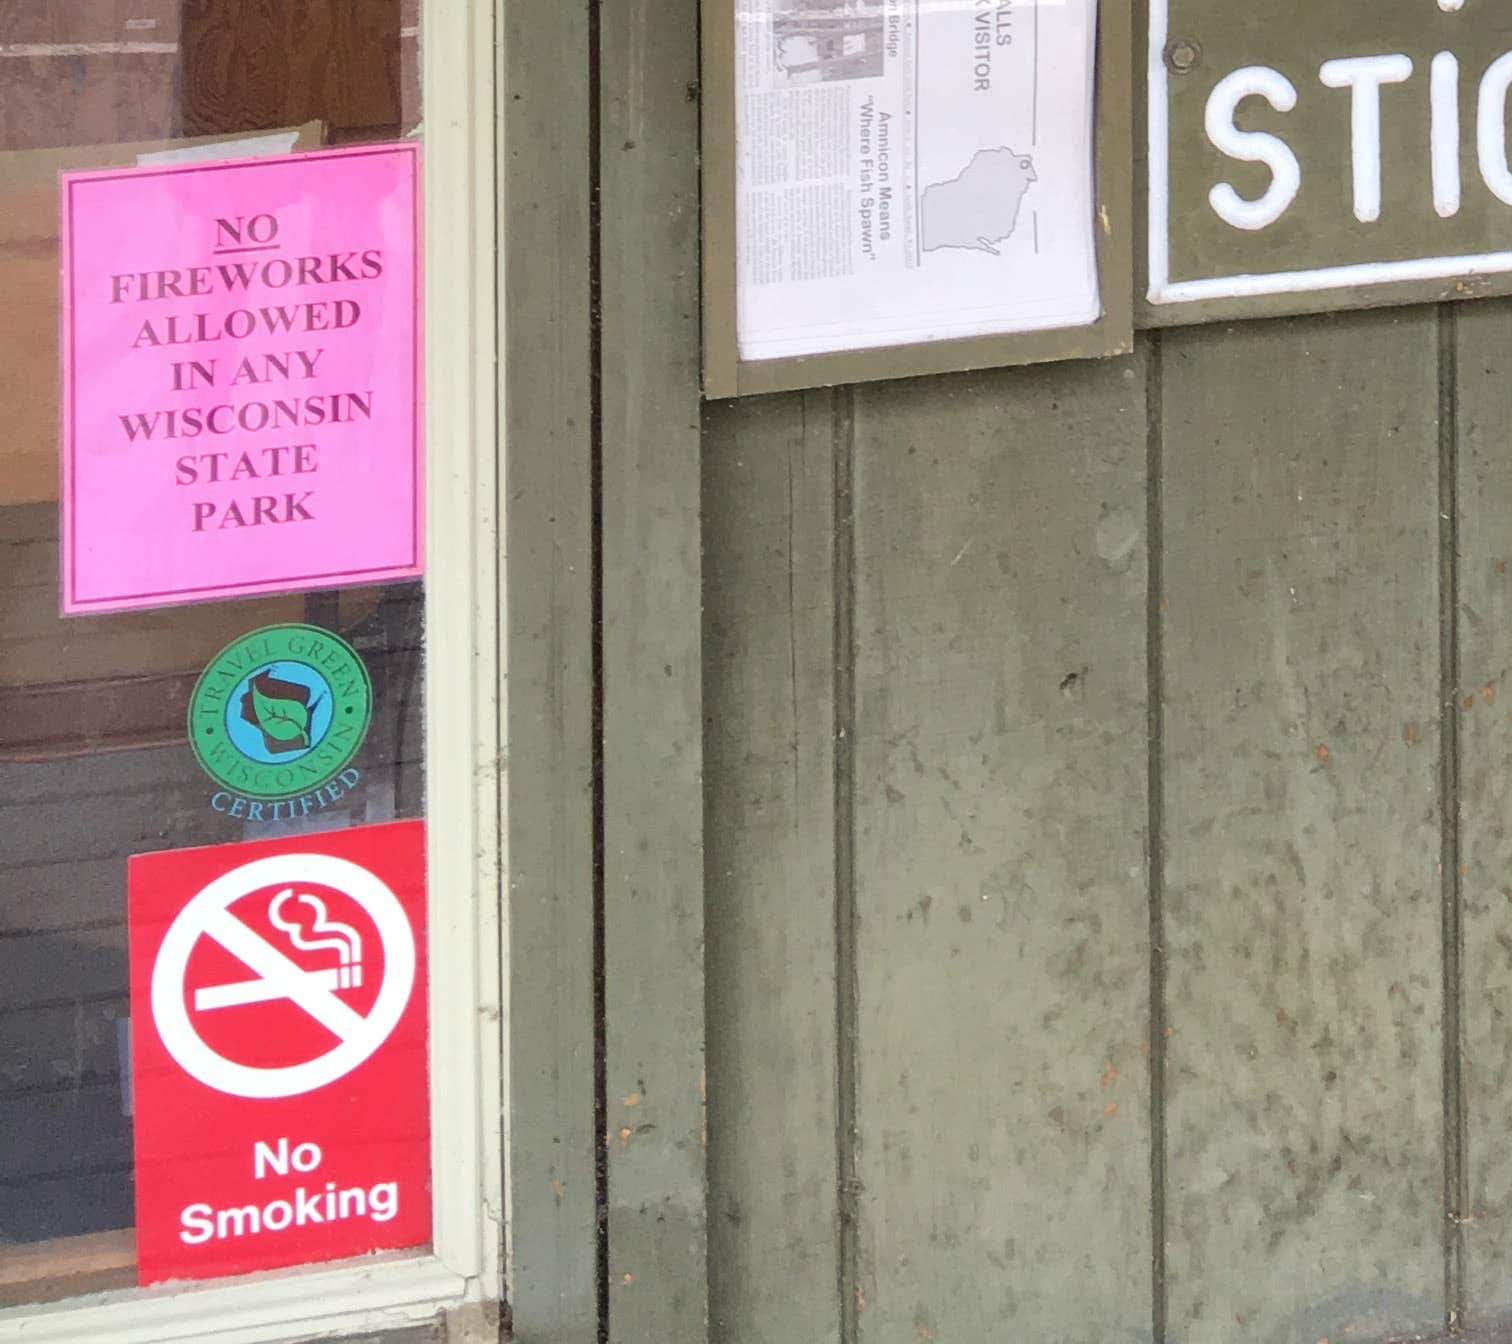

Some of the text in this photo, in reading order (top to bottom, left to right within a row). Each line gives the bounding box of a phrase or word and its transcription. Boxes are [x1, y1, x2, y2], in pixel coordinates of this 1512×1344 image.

[886, 15, 899, 58] Bridge
[974, 11, 991, 92] VISITOR
[860, 160, 874, 193] Fish
[878, 112, 893, 241] Amnicon Means
[213, 213, 280, 252] NO
[110, 250, 383, 304] FIREWORKS
[131, 299, 361, 349] ALLOWED
[170, 348, 325, 391] IN ANY
[118, 391, 374, 443] WISCONSIN
[175, 443, 320, 486] STATE
[193, 491, 316, 532] PARK
[201, 636, 360, 715] TRAVEL GREEN
[210, 722, 354, 787] WISCONSIN
[211, 768, 361, 821] CERTIFIED
[252, 1135, 322, 1180] No
[179, 1180, 400, 1246] Smoking
